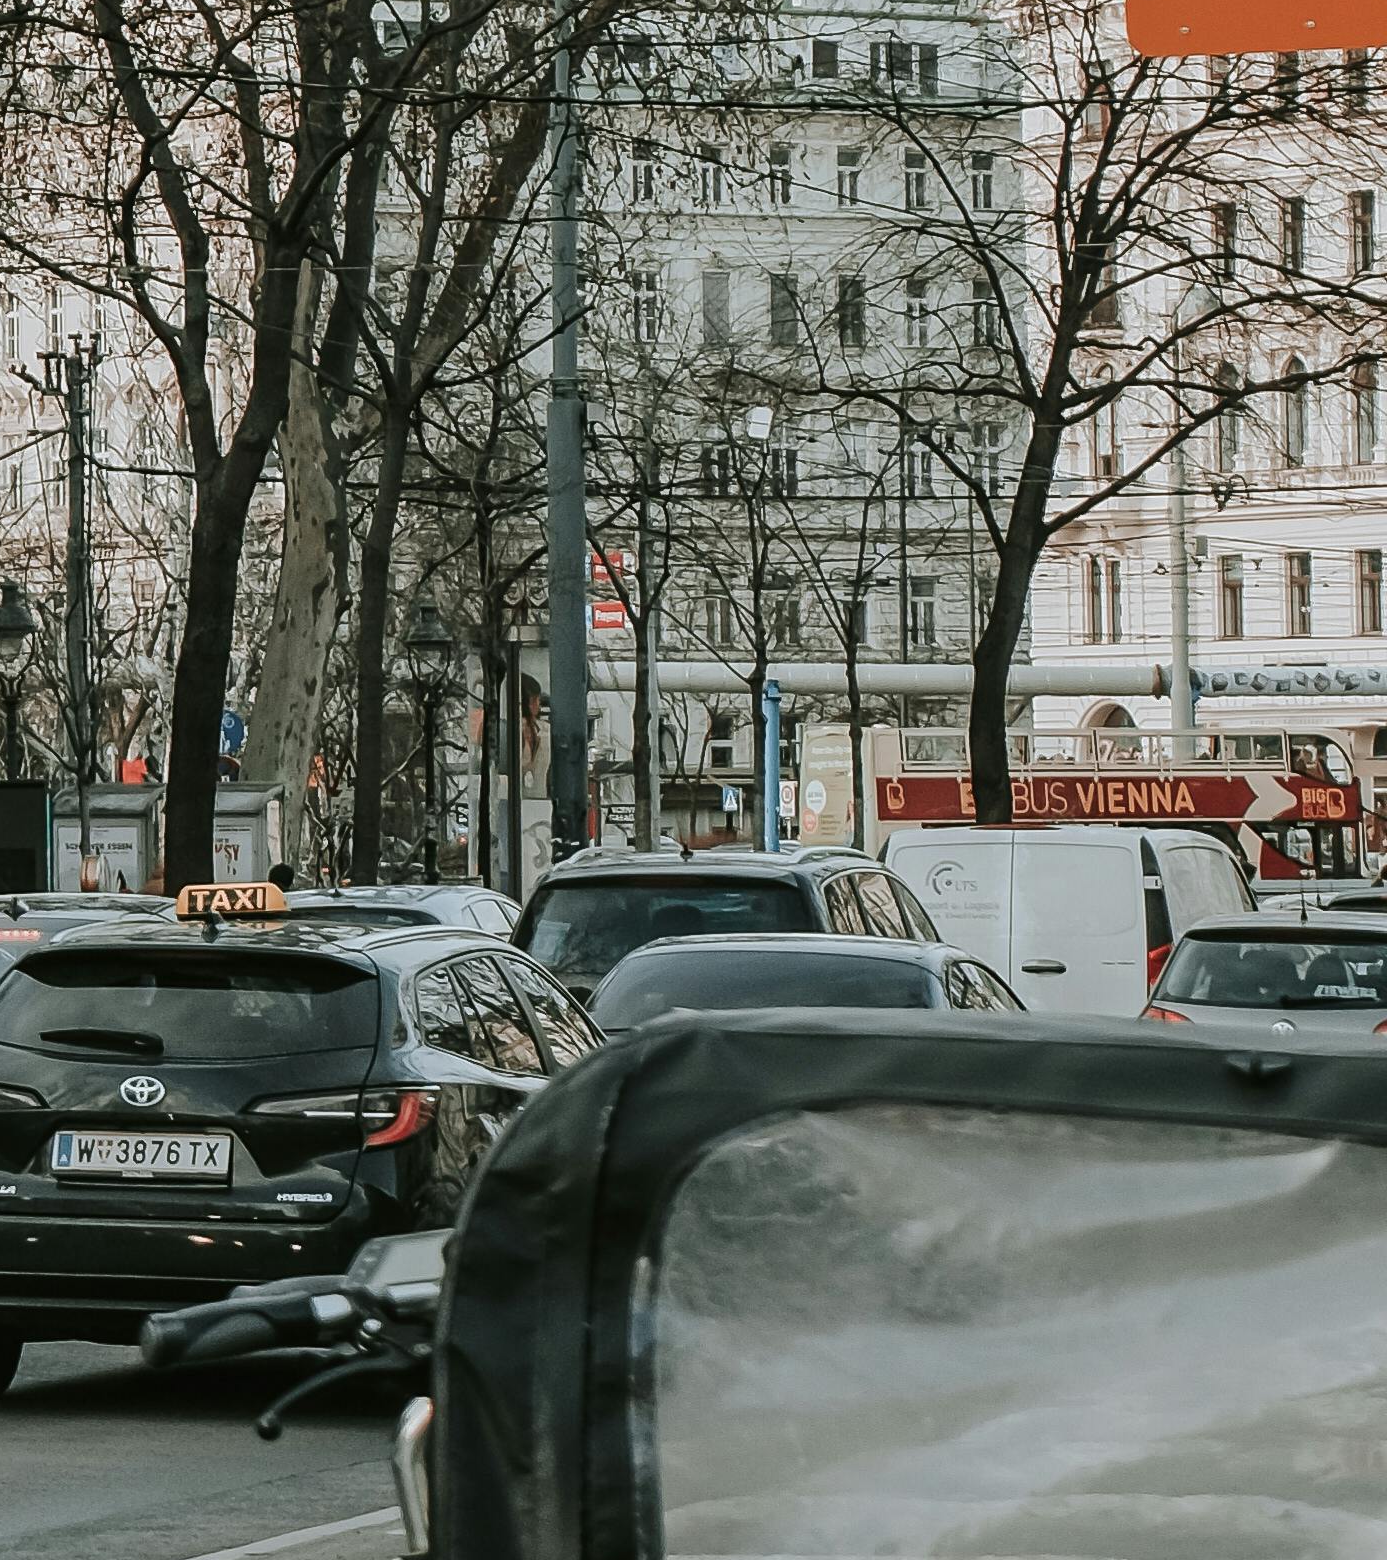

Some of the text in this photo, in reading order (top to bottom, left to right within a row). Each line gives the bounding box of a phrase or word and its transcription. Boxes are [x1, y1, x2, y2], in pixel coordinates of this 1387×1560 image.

[1012, 782, 1068, 815] BUS
[1076, 781, 1196, 814] VIENNA
[1301, 787, 1327, 804] BIG
[190, 887, 264, 912] TAXI
[77, 1138, 95, 1163] W
[115, 1140, 181, 1165] 3876
[189, 1142, 219, 1167] TX
